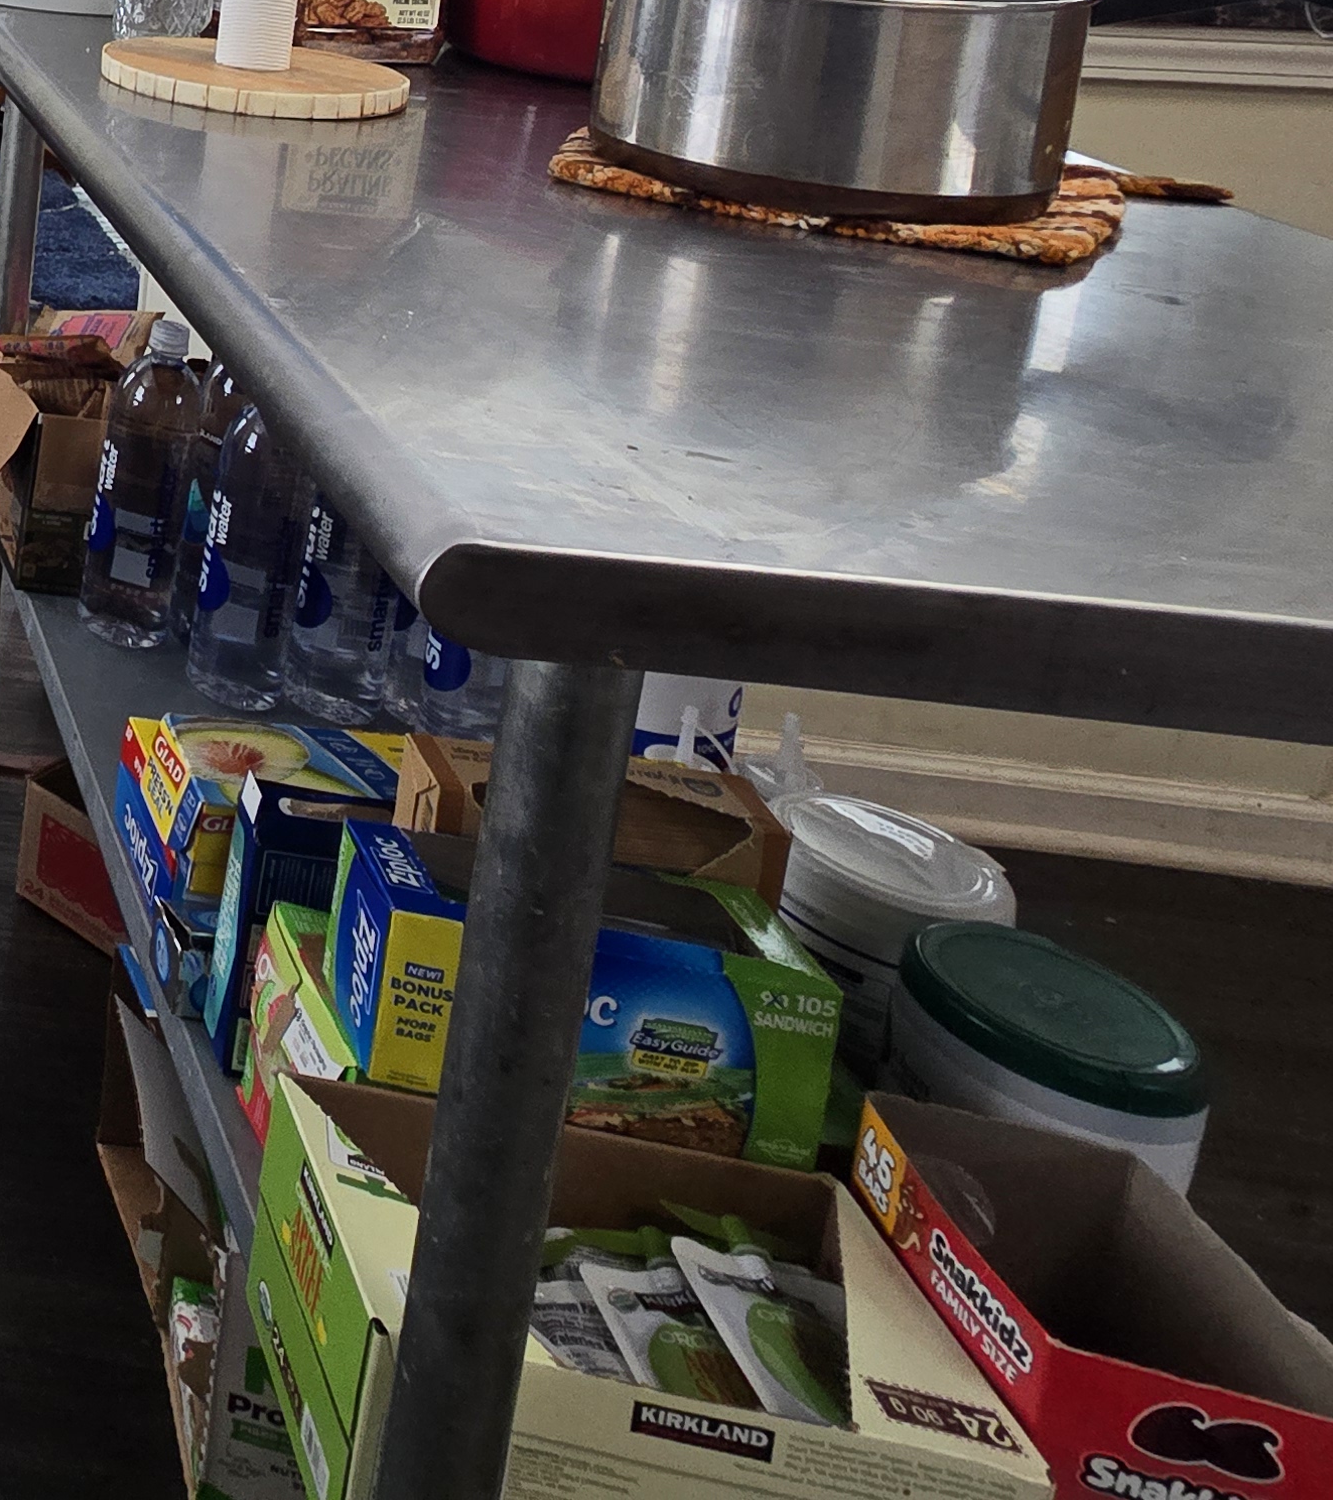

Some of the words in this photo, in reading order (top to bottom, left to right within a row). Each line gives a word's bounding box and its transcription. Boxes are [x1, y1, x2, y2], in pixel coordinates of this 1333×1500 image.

[104, 443, 119, 491] water
[215, 495, 234, 546] water
[315, 511, 334, 561] water
[154, 735, 184, 784] GLAD
[202, 816, 232, 832] GL
[124, 803, 155, 896] Ziploc
[375, 834, 423, 889] Ziploc
[350, 907, 377, 1028] Ziploc
[390, 976, 454, 1003] BONUS
[406, 964, 443, 983] NEW!
[393, 993, 444, 1018] PACK
[396, 1016, 437, 1033] MORE
[752, 1011, 835, 1038] SANDWICH
[796, 995, 837, 1018] 105
[395, 1026, 433, 1043] BAGS
[863, 1127, 895, 1191] 45
[858, 1157, 889, 1215] BARS
[930, 1230, 1033, 1373] Snakkidz
[930, 1268, 982, 1339] FAMILY
[980, 1332, 1018, 1386] SIZE
[640, 1405, 770, 1449] KIRKLAND
